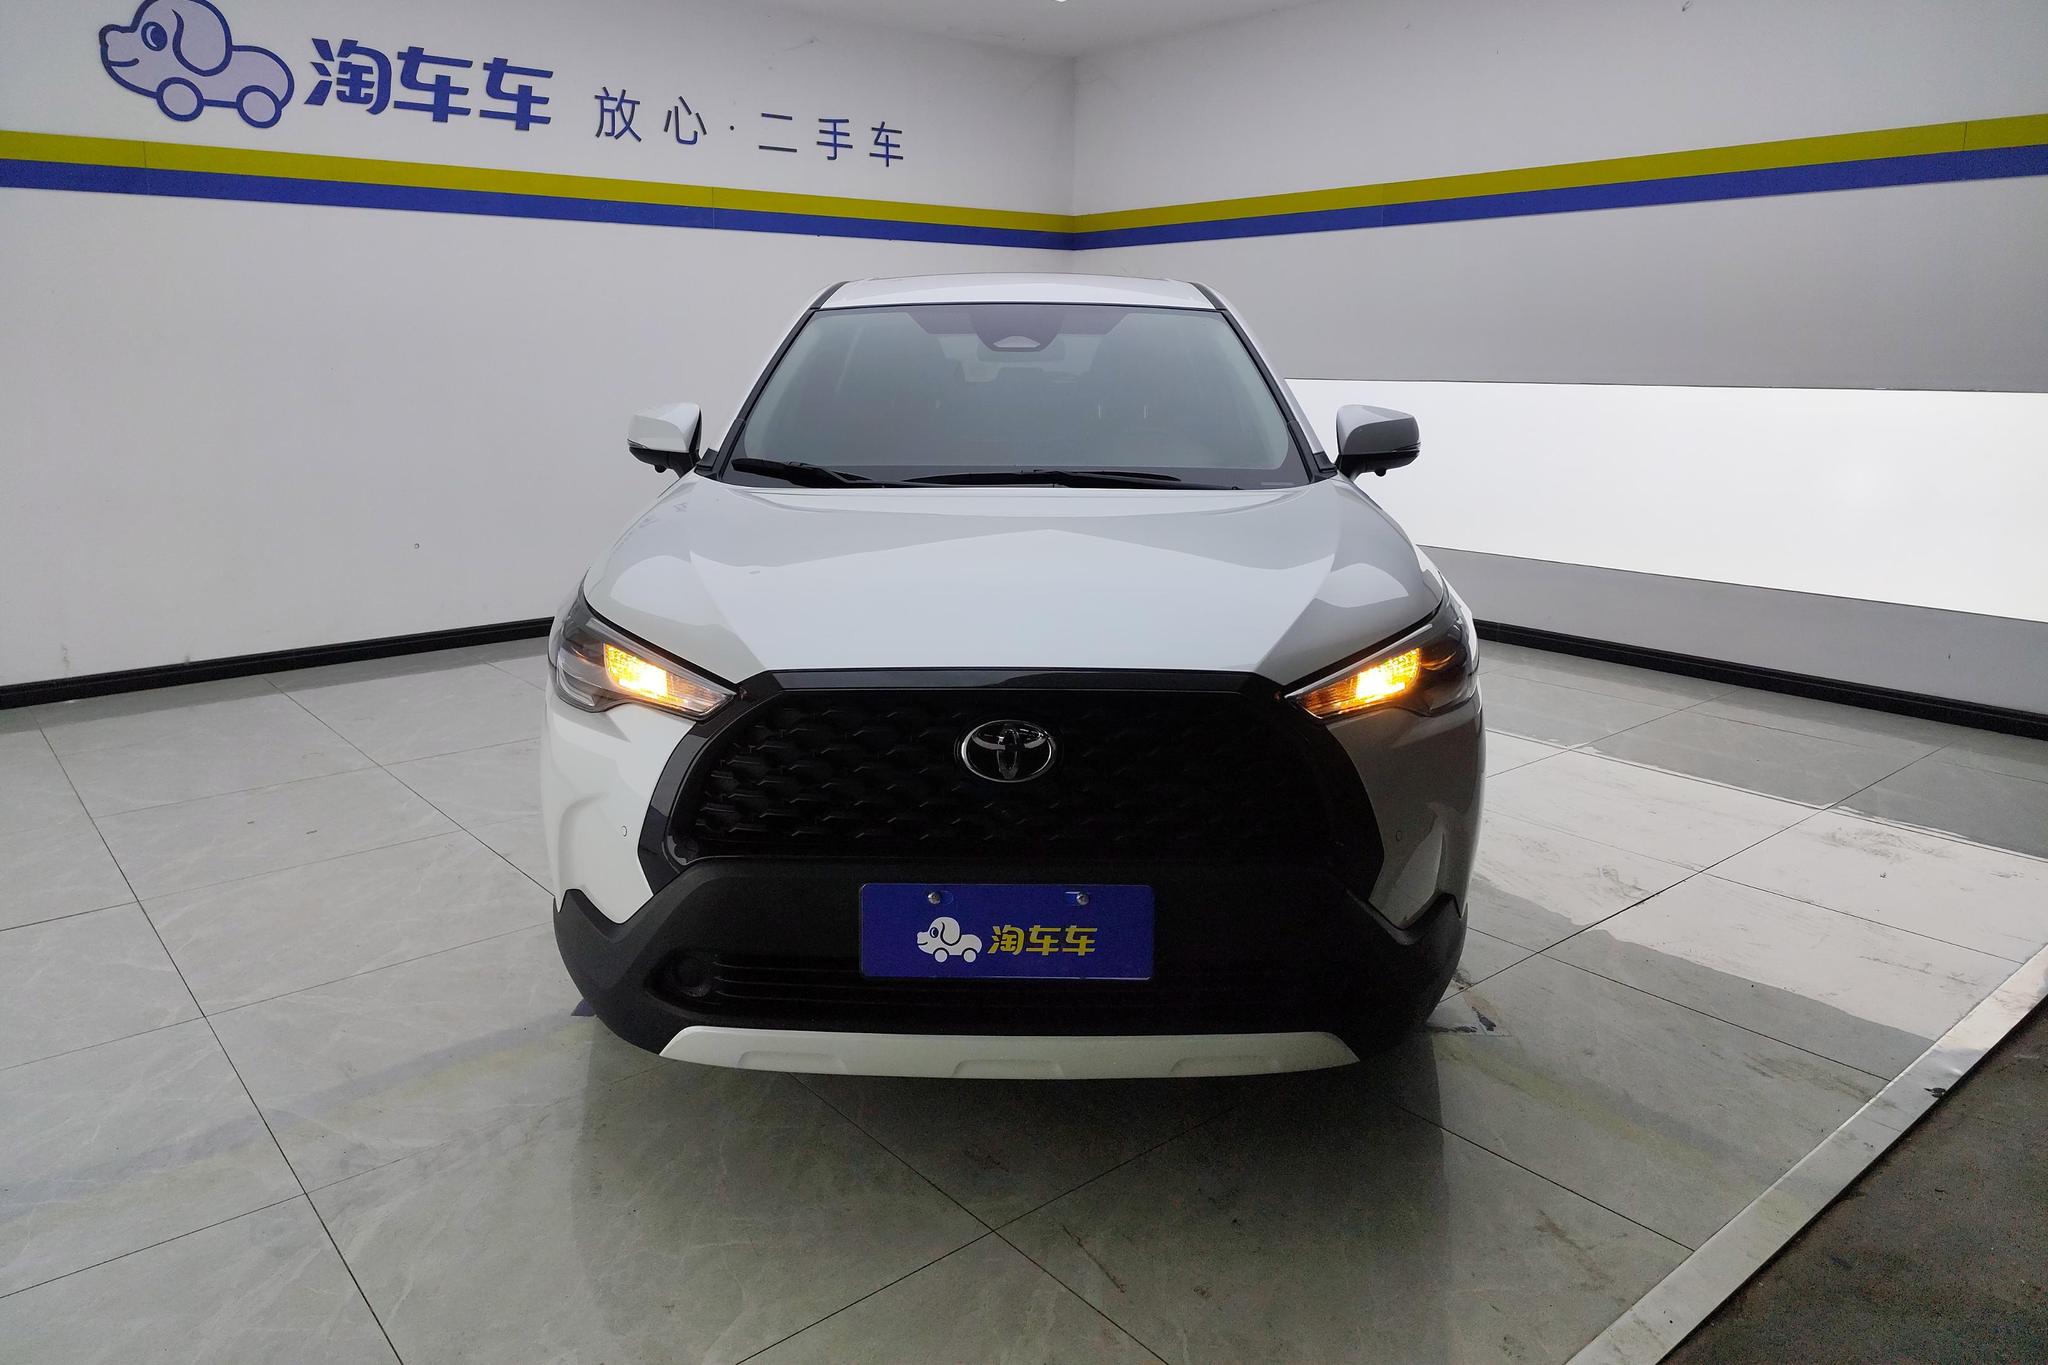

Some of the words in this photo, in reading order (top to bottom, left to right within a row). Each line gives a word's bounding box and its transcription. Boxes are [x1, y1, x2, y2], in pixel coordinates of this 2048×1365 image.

[304, 37, 555, 132] 淘车车
[987, 925, 1098, 956] 淘车车
